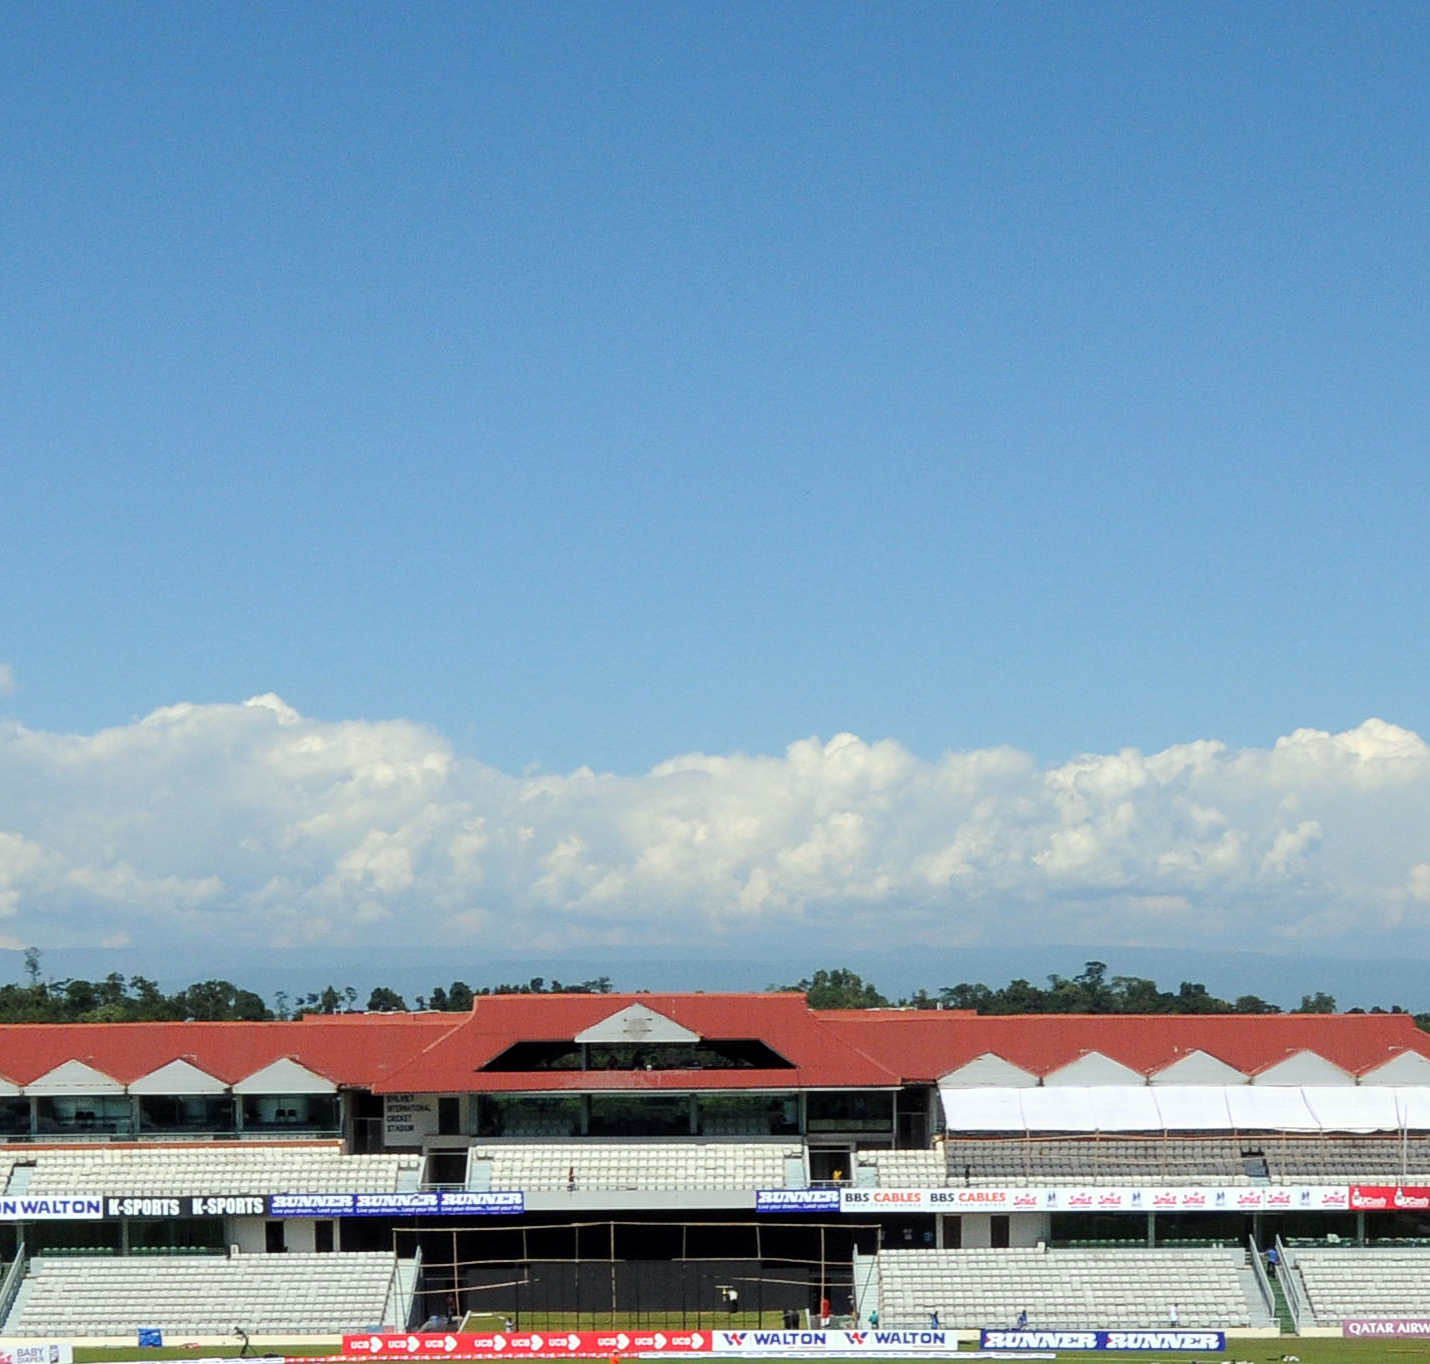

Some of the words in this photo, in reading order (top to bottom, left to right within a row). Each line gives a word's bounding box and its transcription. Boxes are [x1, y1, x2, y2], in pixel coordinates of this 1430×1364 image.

[356, 1194, 438, 1207] RUNNER
[442, 1192, 522, 1205] RUNNER
[758, 1190, 839, 1203] RUNNER
[845, 1193, 869, 1202] BBS
[873, 1193, 922, 1202] CABLES
[930, 1193, 955, 1202] BBS
[958, 1192, 1006, 1202] CABLES
[192, 1197, 264, 1214] K-SPORTS
[272, 1195, 354, 1208] RUNNER
[20, 1200, 100, 1214] WALTON
[109, 1199, 180, 1216] K-SPORTS
[1349, 1322, 1394, 1335] QATAR
[548, 1338, 567, 1347] UCB
[598, 1337, 617, 1346] UCB
[635, 1337, 654, 1346] UCB
[672, 1337, 691, 1346] UCB
[753, 1333, 826, 1344] WALTON
[874, 1332, 945, 1344] WALTON
[985, 1333, 1097, 1348] RUNNER
[1106, 1333, 1219, 1349] RUNNER
[350, 1340, 369, 1349] UCB
[388, 1340, 407, 1349] UCB
[425, 1340, 444, 1349] UCB
[474, 1339, 493, 1348] UCB
[511, 1339, 530, 1347] UCB
[17, 1348, 44, 1357] BABY
[17, 1355, 44, 1364] DIAPER
